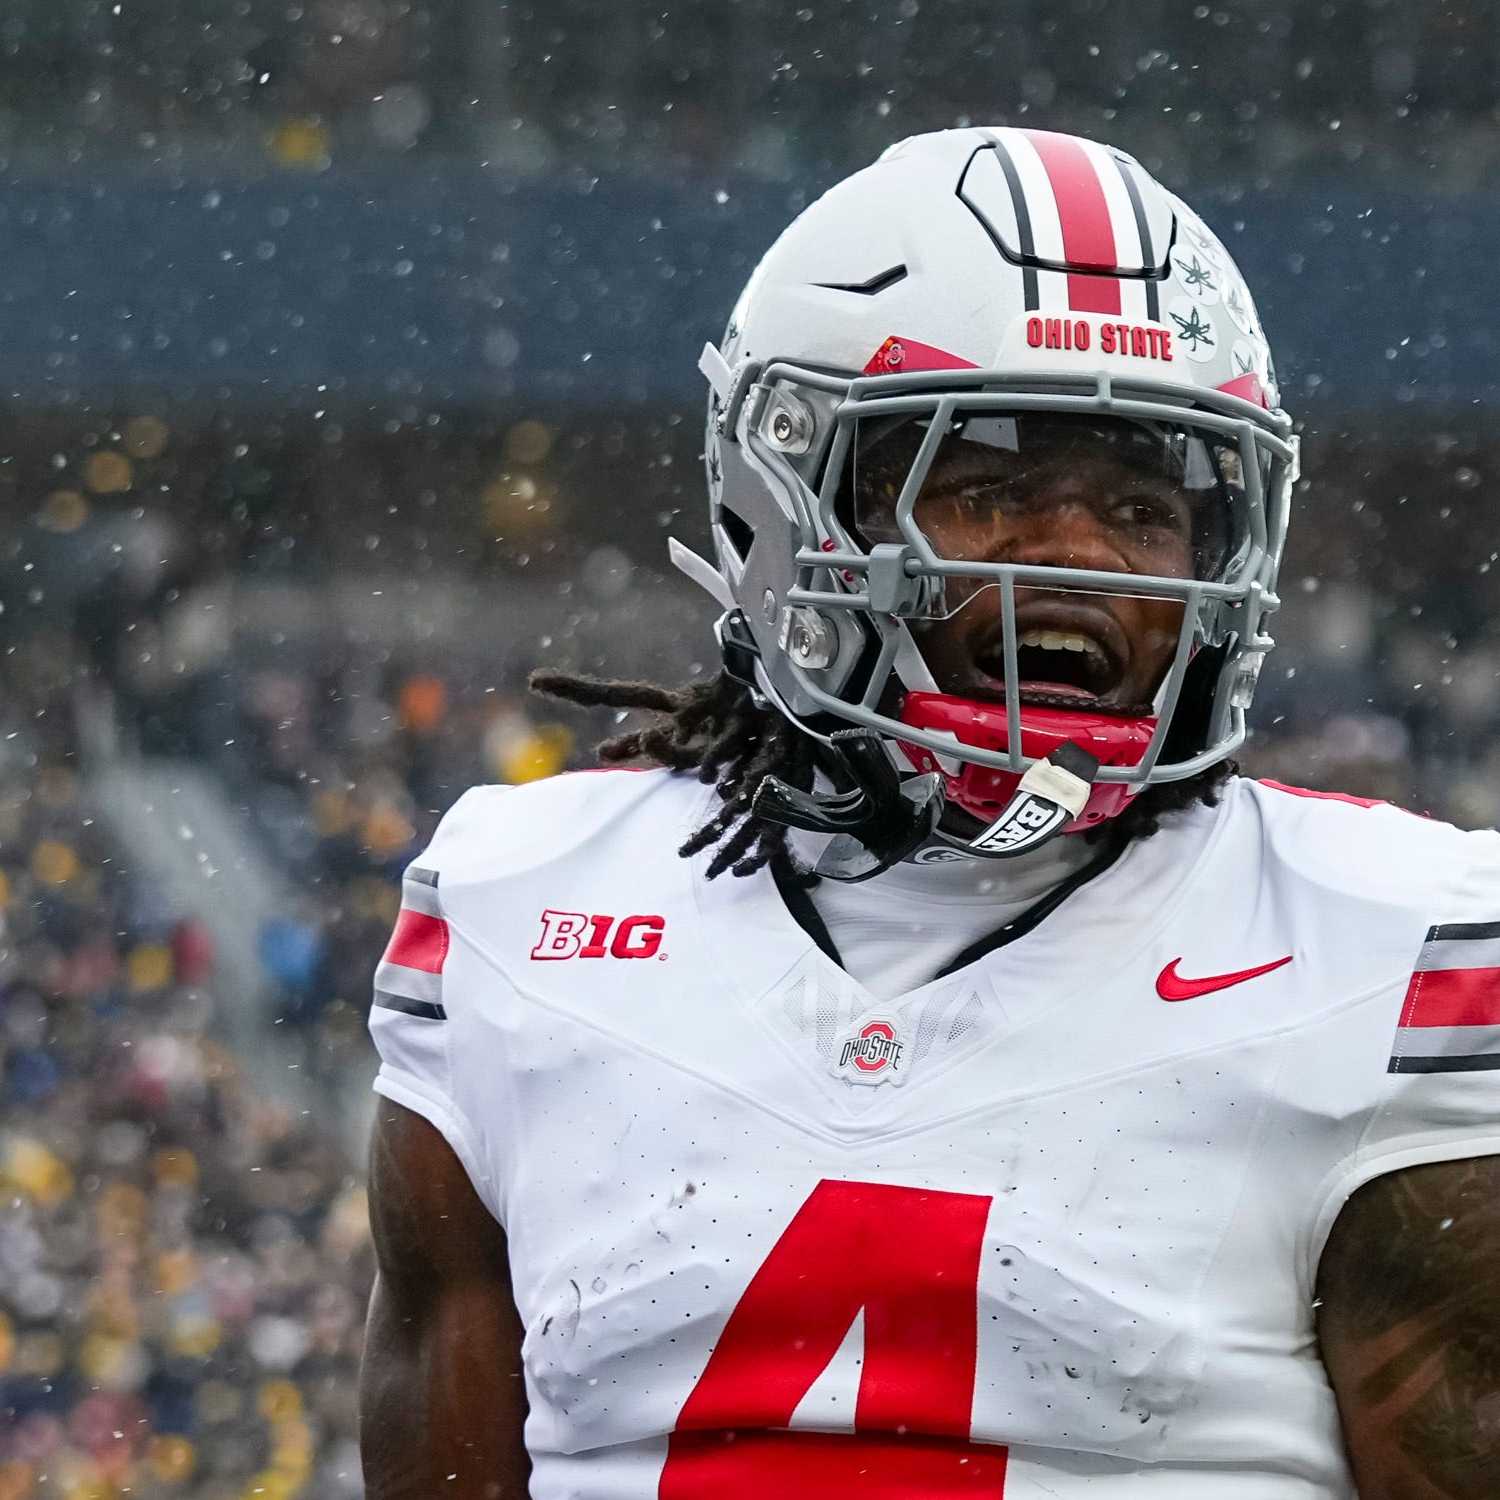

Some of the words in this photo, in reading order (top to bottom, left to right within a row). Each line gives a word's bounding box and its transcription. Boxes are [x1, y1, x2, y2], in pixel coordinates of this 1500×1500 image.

[1027, 317, 1091, 351] OHIO
[1100, 323, 1173, 361] STATE
[839, 1038, 871, 1067] OHIO
[868, 1035, 904, 1071] STATE
